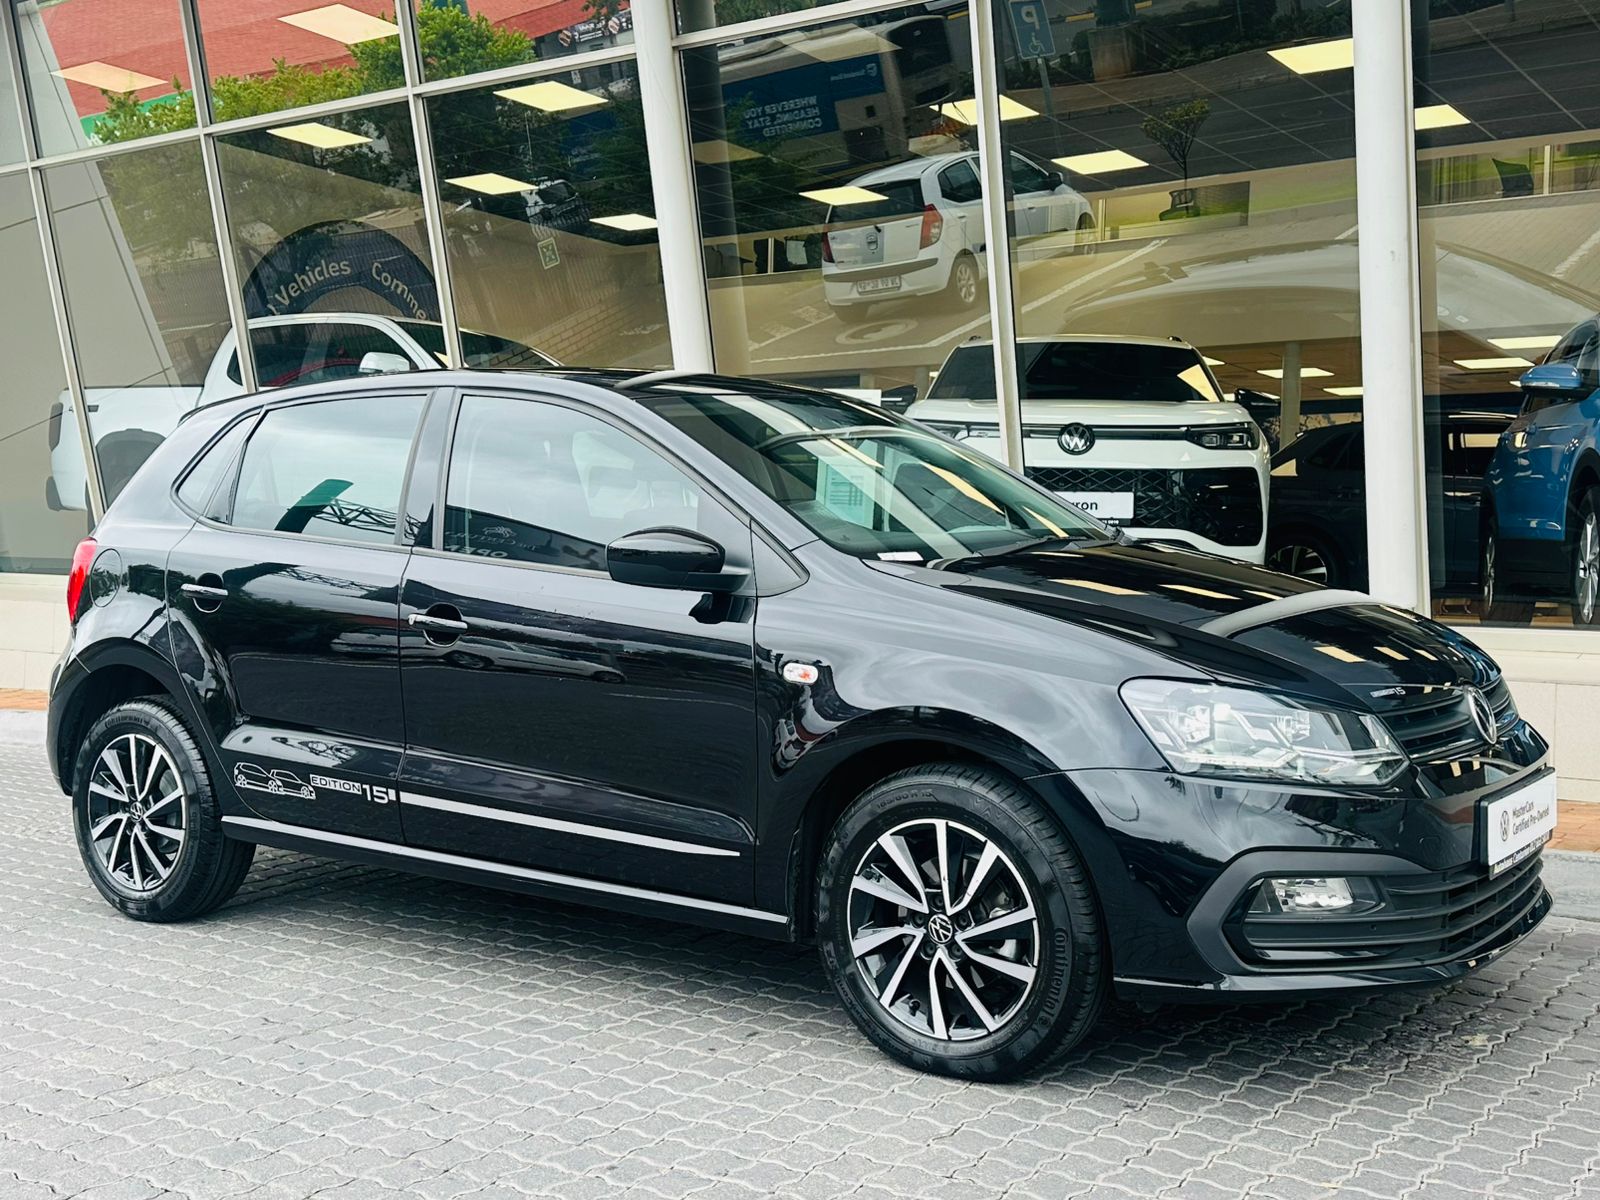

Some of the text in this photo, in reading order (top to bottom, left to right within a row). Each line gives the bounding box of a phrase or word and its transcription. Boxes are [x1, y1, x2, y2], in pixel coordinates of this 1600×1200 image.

[274, 259, 351, 306] Vehicles
[1072, 500, 1098, 511] ron
[310, 774, 362, 795] EDITION
[1512, 803, 1549, 835] Certified Pre-Owned
[1040, 926, 1068, 1018] Continental
